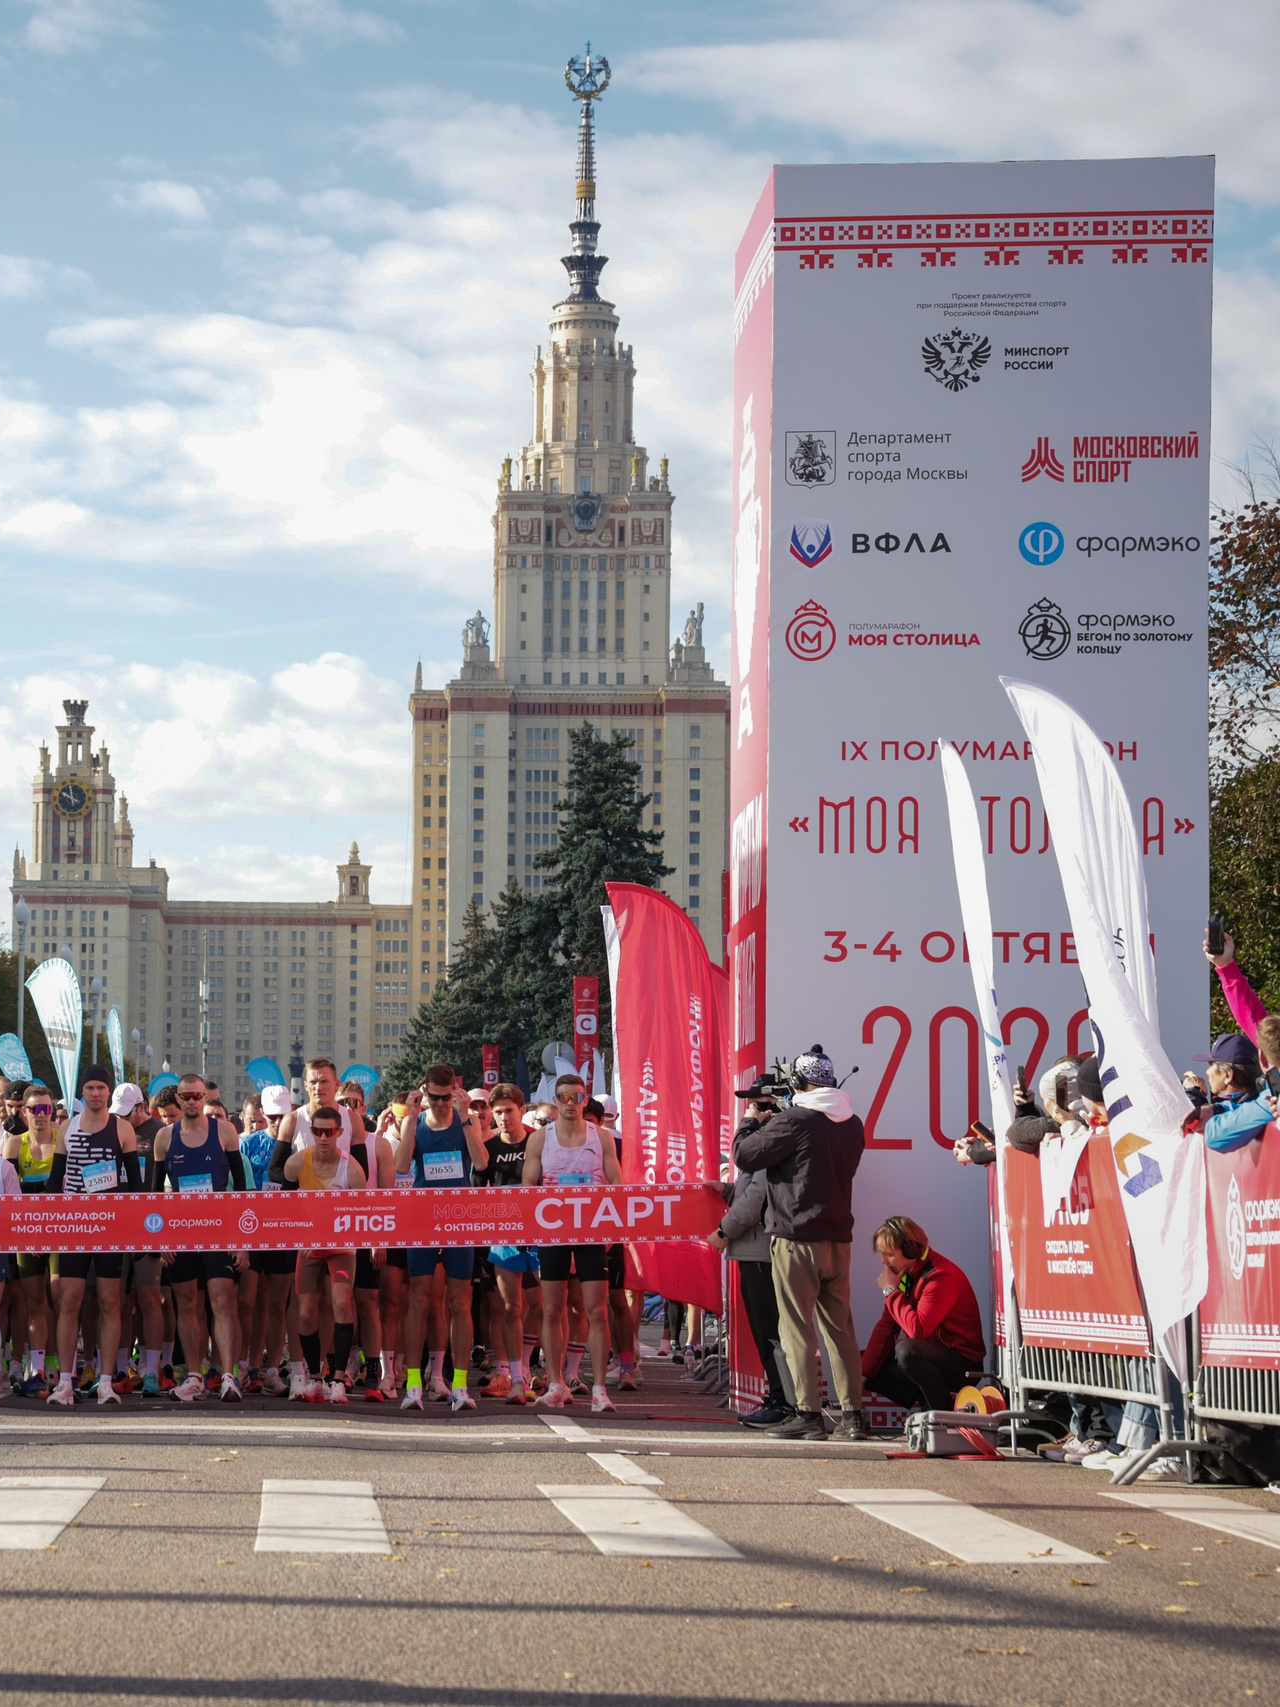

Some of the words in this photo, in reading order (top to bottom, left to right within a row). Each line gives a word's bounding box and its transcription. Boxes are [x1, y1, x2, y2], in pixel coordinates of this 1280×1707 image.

[943, 309, 991, 317] Российской
[992, 309, 1039, 317] Федерации
[1004, 347, 1070, 357] МИНСПОРТ
[1004, 361, 1054, 370] РОССИИ
[847, 432, 952, 447] Департамент
[1073, 431, 1200, 459] МОСКОВСКИЙ
[847, 452, 901, 465] спорта
[848, 470, 901, 484] города
[906, 467, 968, 480] Москвы
[1073, 460, 1132, 483] СПОРТ
[851, 531, 952, 554] ВФЛА
[1076, 535, 1201, 557] фармэко
[1077, 614, 1175, 631] фармэко
[848, 634, 888, 646] МОЯ
[892, 633, 981, 647] СТОЛИЦА
[1077, 633, 1112, 641] БЕГОМ
[1114, 633, 1131, 641] ПО
[1133, 633, 1194, 641] ЗОЛОТОМУ
[1077, 646, 1122, 654] КОЛЬЦУ
[841, 741, 869, 761] IX
[823, 931, 902, 963] 3-4
[496, 1151, 527, 1163] NIK
[429, 1166, 454, 1176] 21635
[87, 1175, 113, 1187] 23870
[11, 1212, 22, 1221] IX
[24, 1211, 116, 1221] ПОЛУМАРАФОН
[433, 1203, 523, 1219] МОСКВА
[534, 1195, 681, 1230] СТАРТ
[11, 1224, 43, 1234] «МОЯ
[45, 1224, 107, 1234] СТОЛИЦА»
[168, 1218, 223, 1229] фармэко
[279, 1220, 314, 1228] СТОЛИЦА
[355, 1214, 397, 1232] ПСБ
[434, 1223, 442, 1232] 4
[443, 1222, 496, 1232] ОКТЯБРЯ
[498, 1221, 524, 1231] 2026
